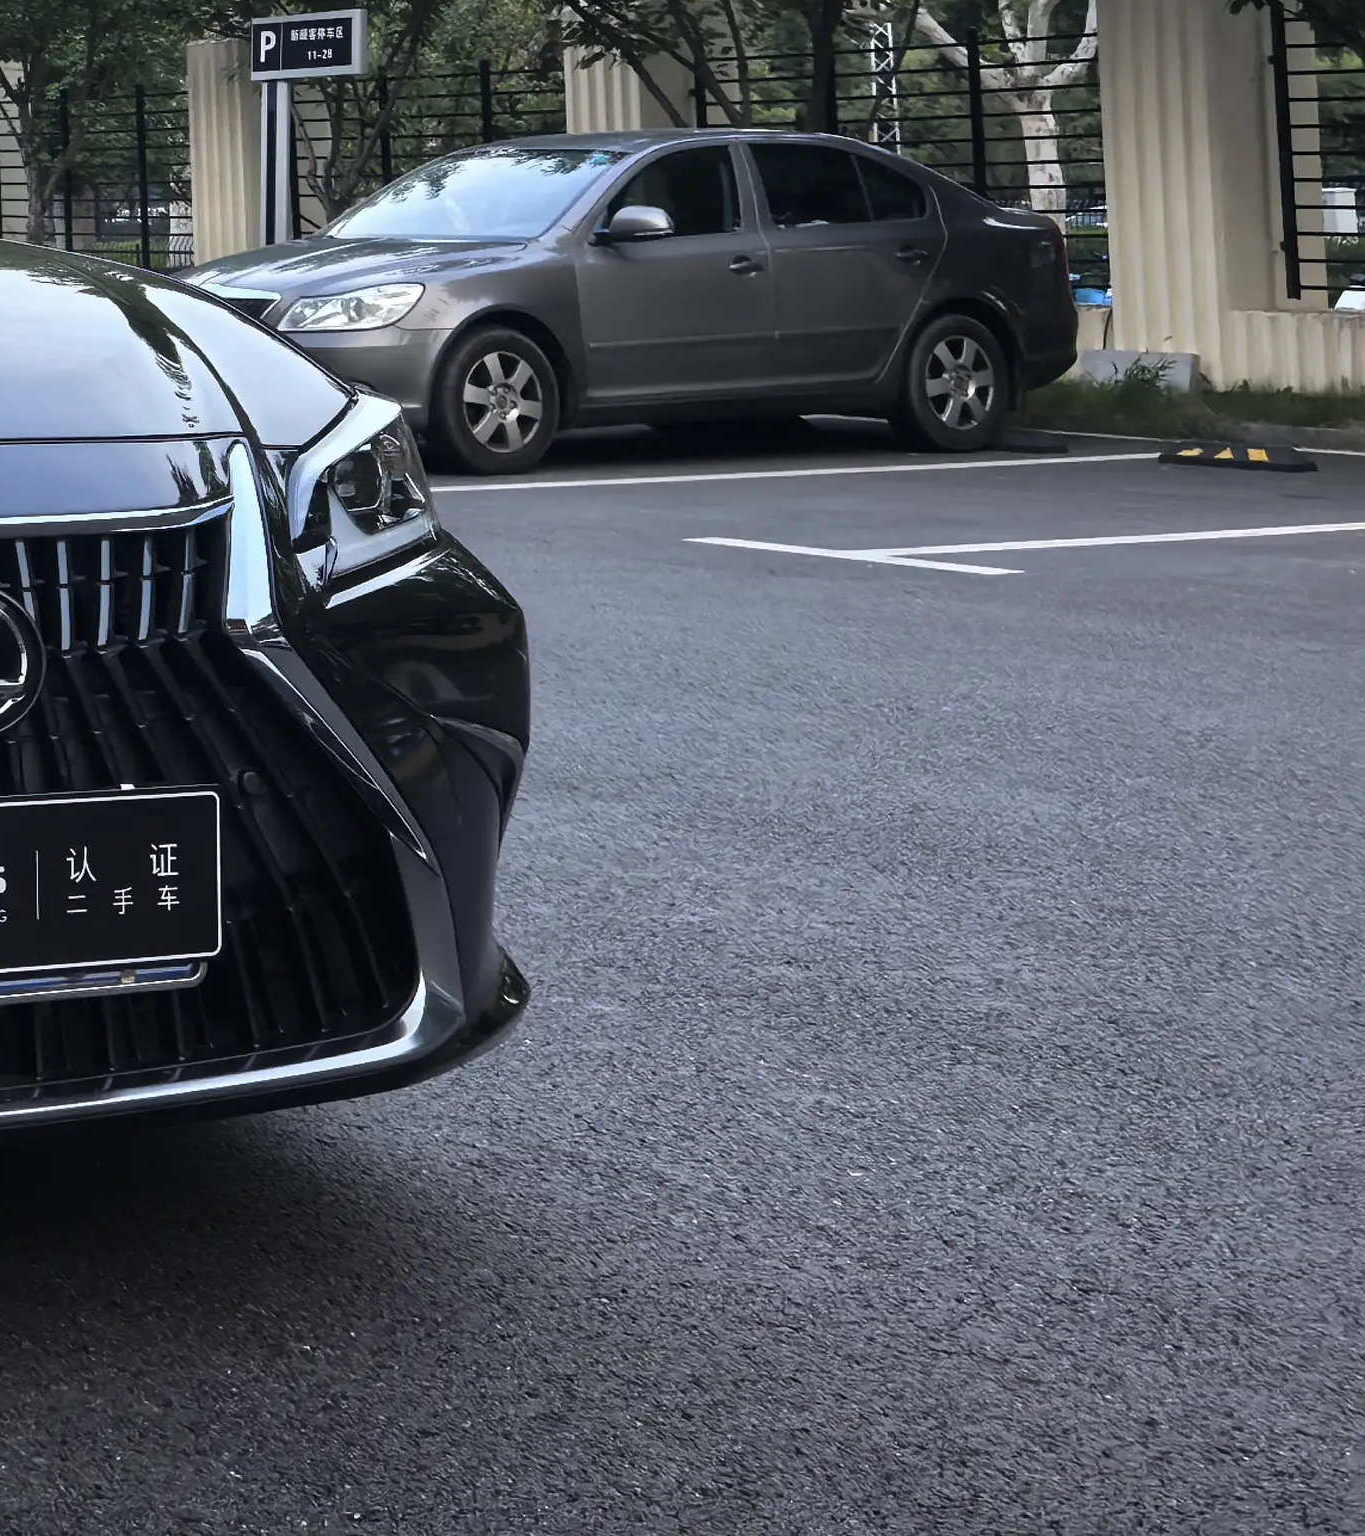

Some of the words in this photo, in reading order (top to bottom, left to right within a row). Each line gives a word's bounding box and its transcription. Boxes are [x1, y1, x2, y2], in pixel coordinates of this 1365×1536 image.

[259, 30, 277, 63] P
[307, 48, 333, 61] 11-28
[66, 843, 179, 884] 认证
[66, 884, 180, 916] 二手车
